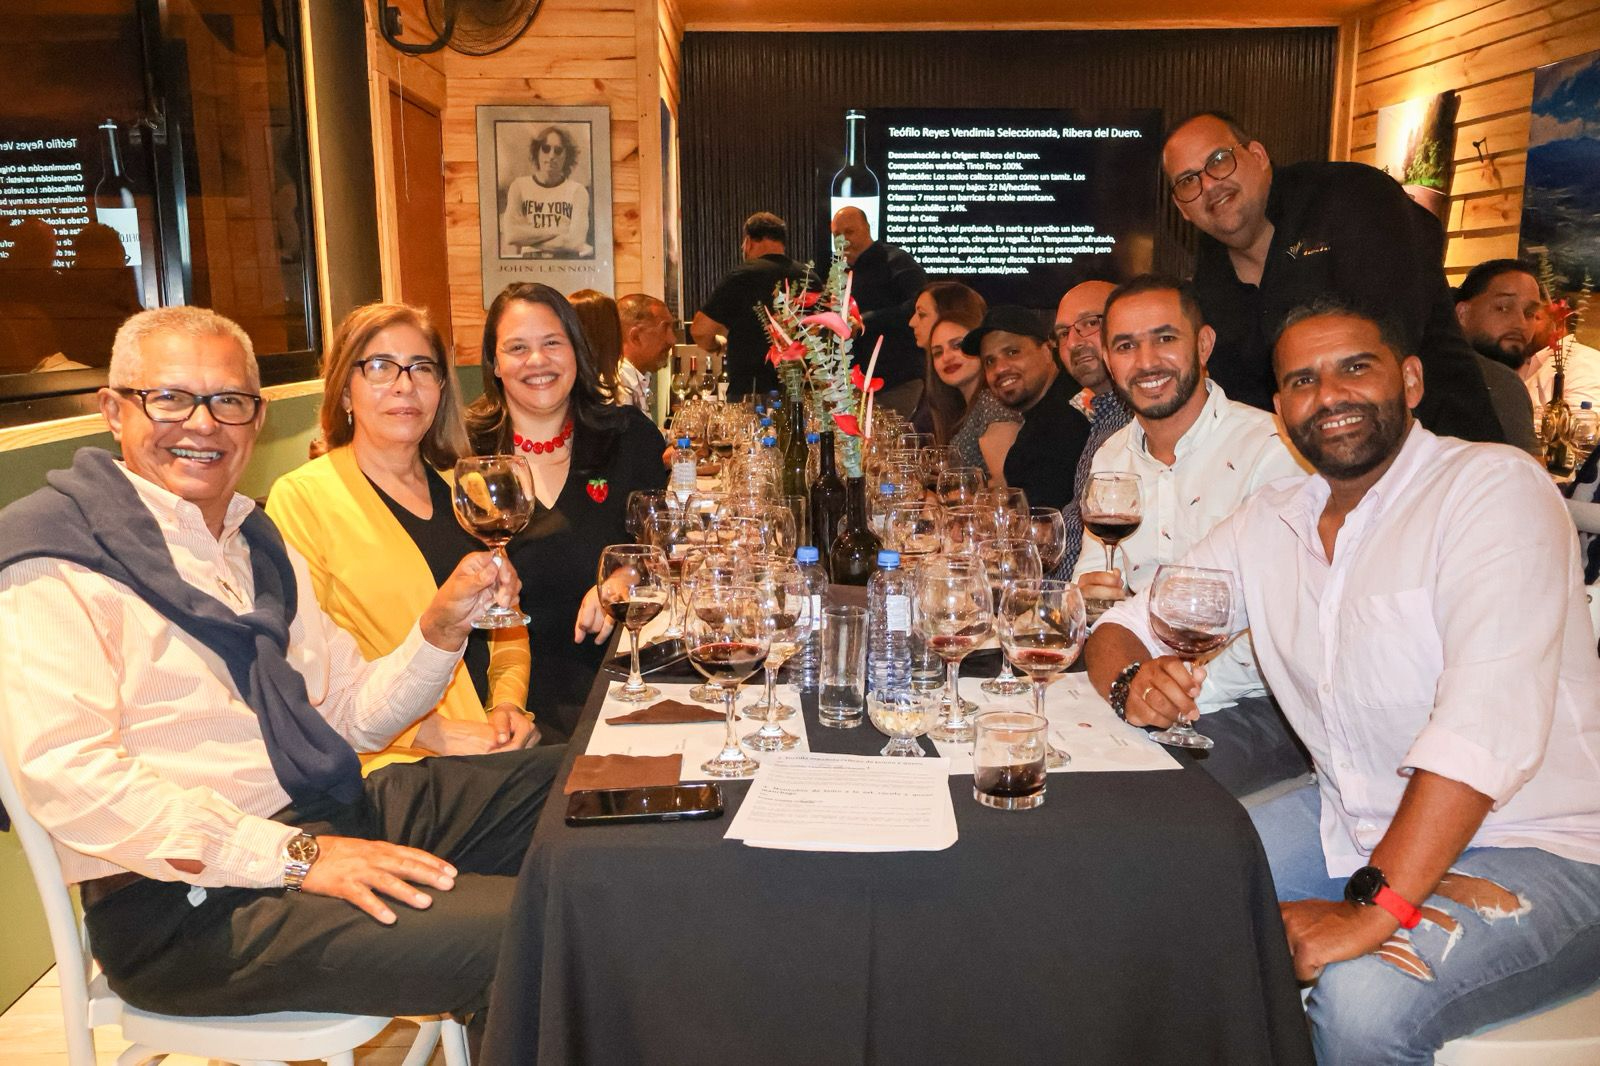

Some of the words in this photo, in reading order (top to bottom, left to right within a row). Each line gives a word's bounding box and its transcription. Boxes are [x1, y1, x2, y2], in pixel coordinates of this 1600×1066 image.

[889, 127, 920, 137] Teófilo
[922, 128, 949, 139] Reyes
[951, 128, 995, 137] Vendimia
[997, 128, 1060, 139] Seleccionada,
[1062, 128, 1092, 138] Ribera
[1094, 128, 1109, 138] del
[1111, 128, 1142, 138] Duero.
[952, 152, 979, 160] Origen:
[888, 162, 934, 171] Composición
[966, 183, 987, 192] bajos:
[522, 200, 544, 216] NEW
[534, 214, 562, 228] CITY
[928, 225, 959, 234] rojo-rubí
[960, 225, 994, 234] profundo.
[1033, 225, 1059, 234] percibe
[887, 235, 916, 244] bouquet
[1005, 236, 1030, 244] regaliz.
[1042, 236, 1083, 244] Tempranillo
[1084, 236, 1116, 244] afrutado,
[958, 246, 985, 254] paladar,
[1055, 246, 1094, 254] perceptible
[978, 266, 1029, 274] calidad/precio.
